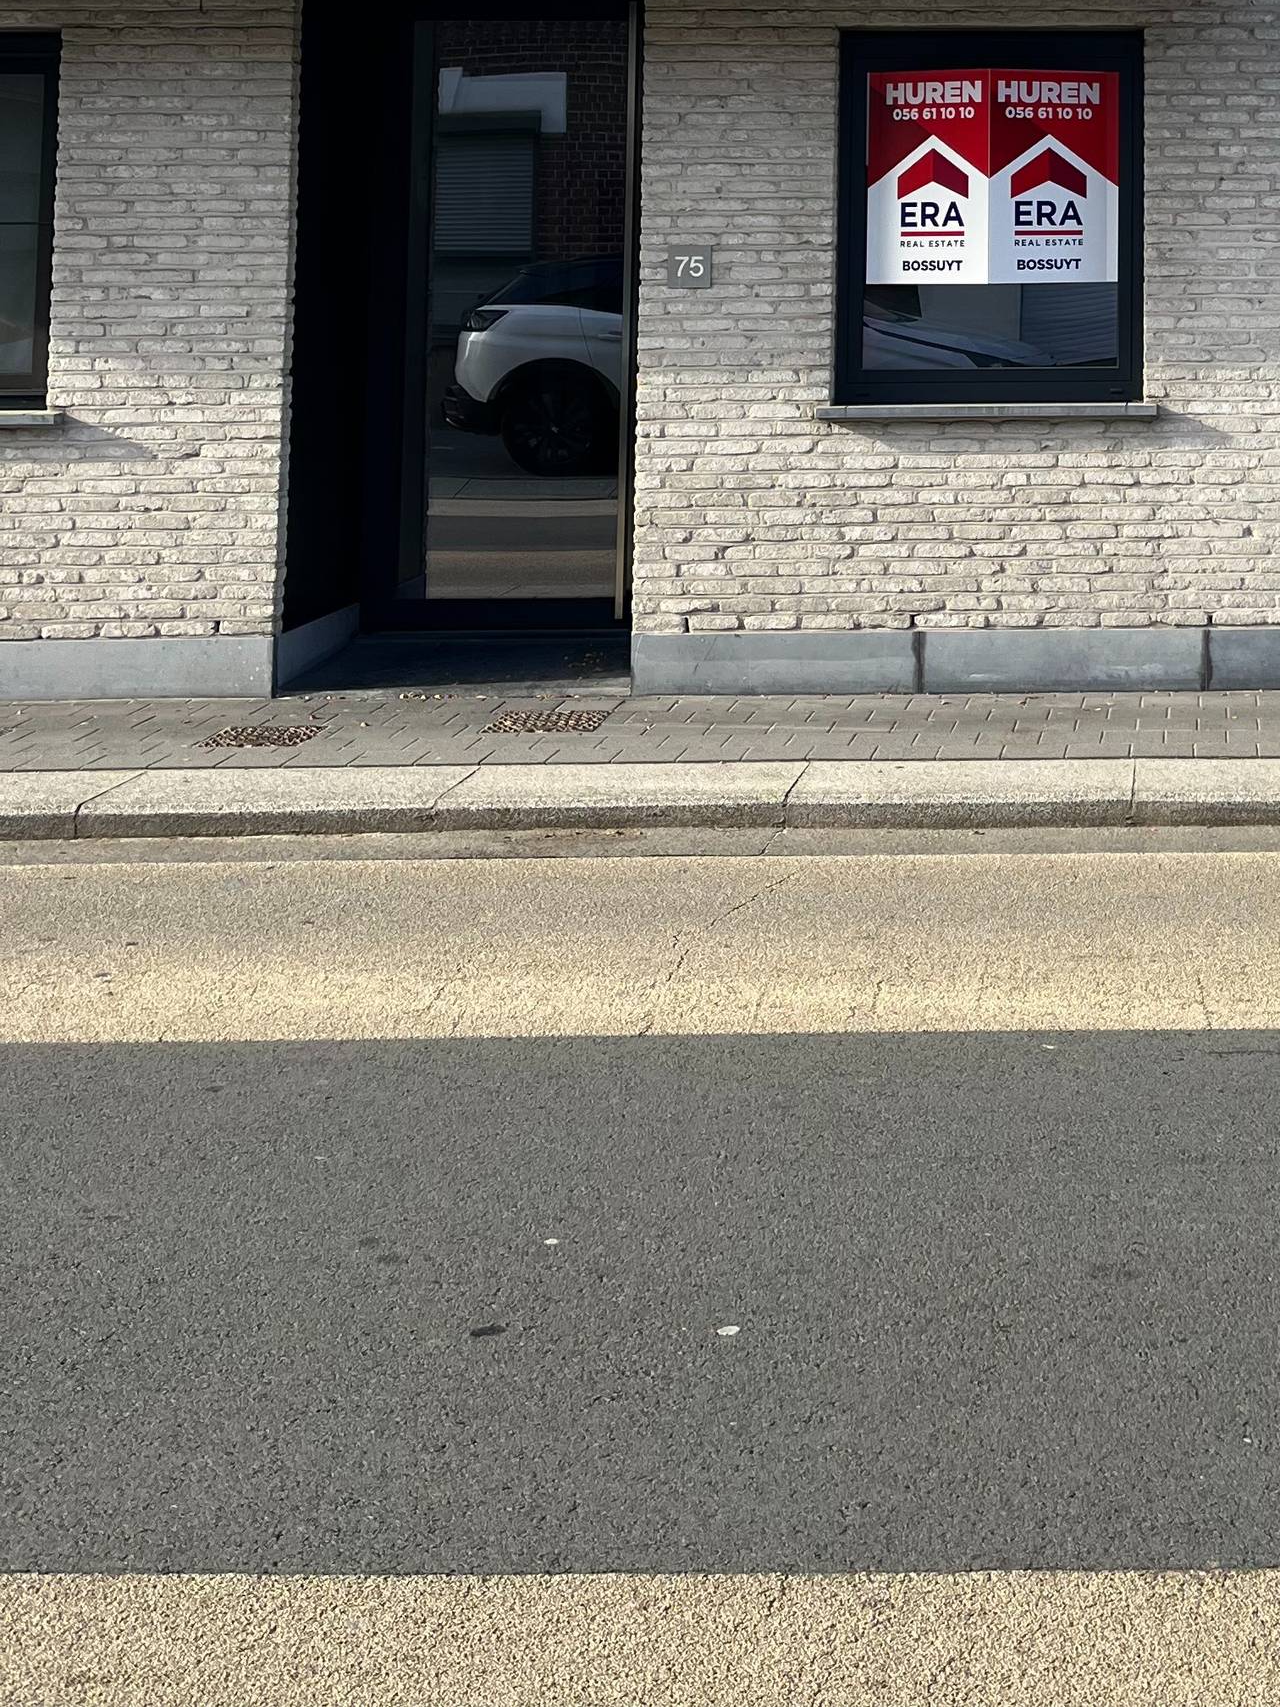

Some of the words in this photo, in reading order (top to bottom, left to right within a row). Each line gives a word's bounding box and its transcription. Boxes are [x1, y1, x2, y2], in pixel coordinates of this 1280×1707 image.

[885, 80, 982, 105] HUREN
[997, 80, 1100, 105] HUREN
[893, 108, 919, 121] 056
[922, 107, 937, 120] 61
[940, 107, 956, 120] 10
[959, 106, 975, 119] 10
[1005, 106, 1034, 119] 056
[1037, 107, 1053, 119] 61
[1056, 107, 1073, 120] 10
[1076, 108, 1093, 120] 10
[900, 201, 965, 227] ERA
[1014, 200, 1084, 226] ERA
[900, 240, 925, 248] REAL
[928, 239, 965, 248] ESTATE
[1014, 239, 1041, 247] REAL
[1045, 238, 1084, 246] ESTATE
[674, 256, 704, 277] 75
[902, 260, 963, 271] BOSSUYT
[1016, 258, 1082, 271] BOSSUYT
